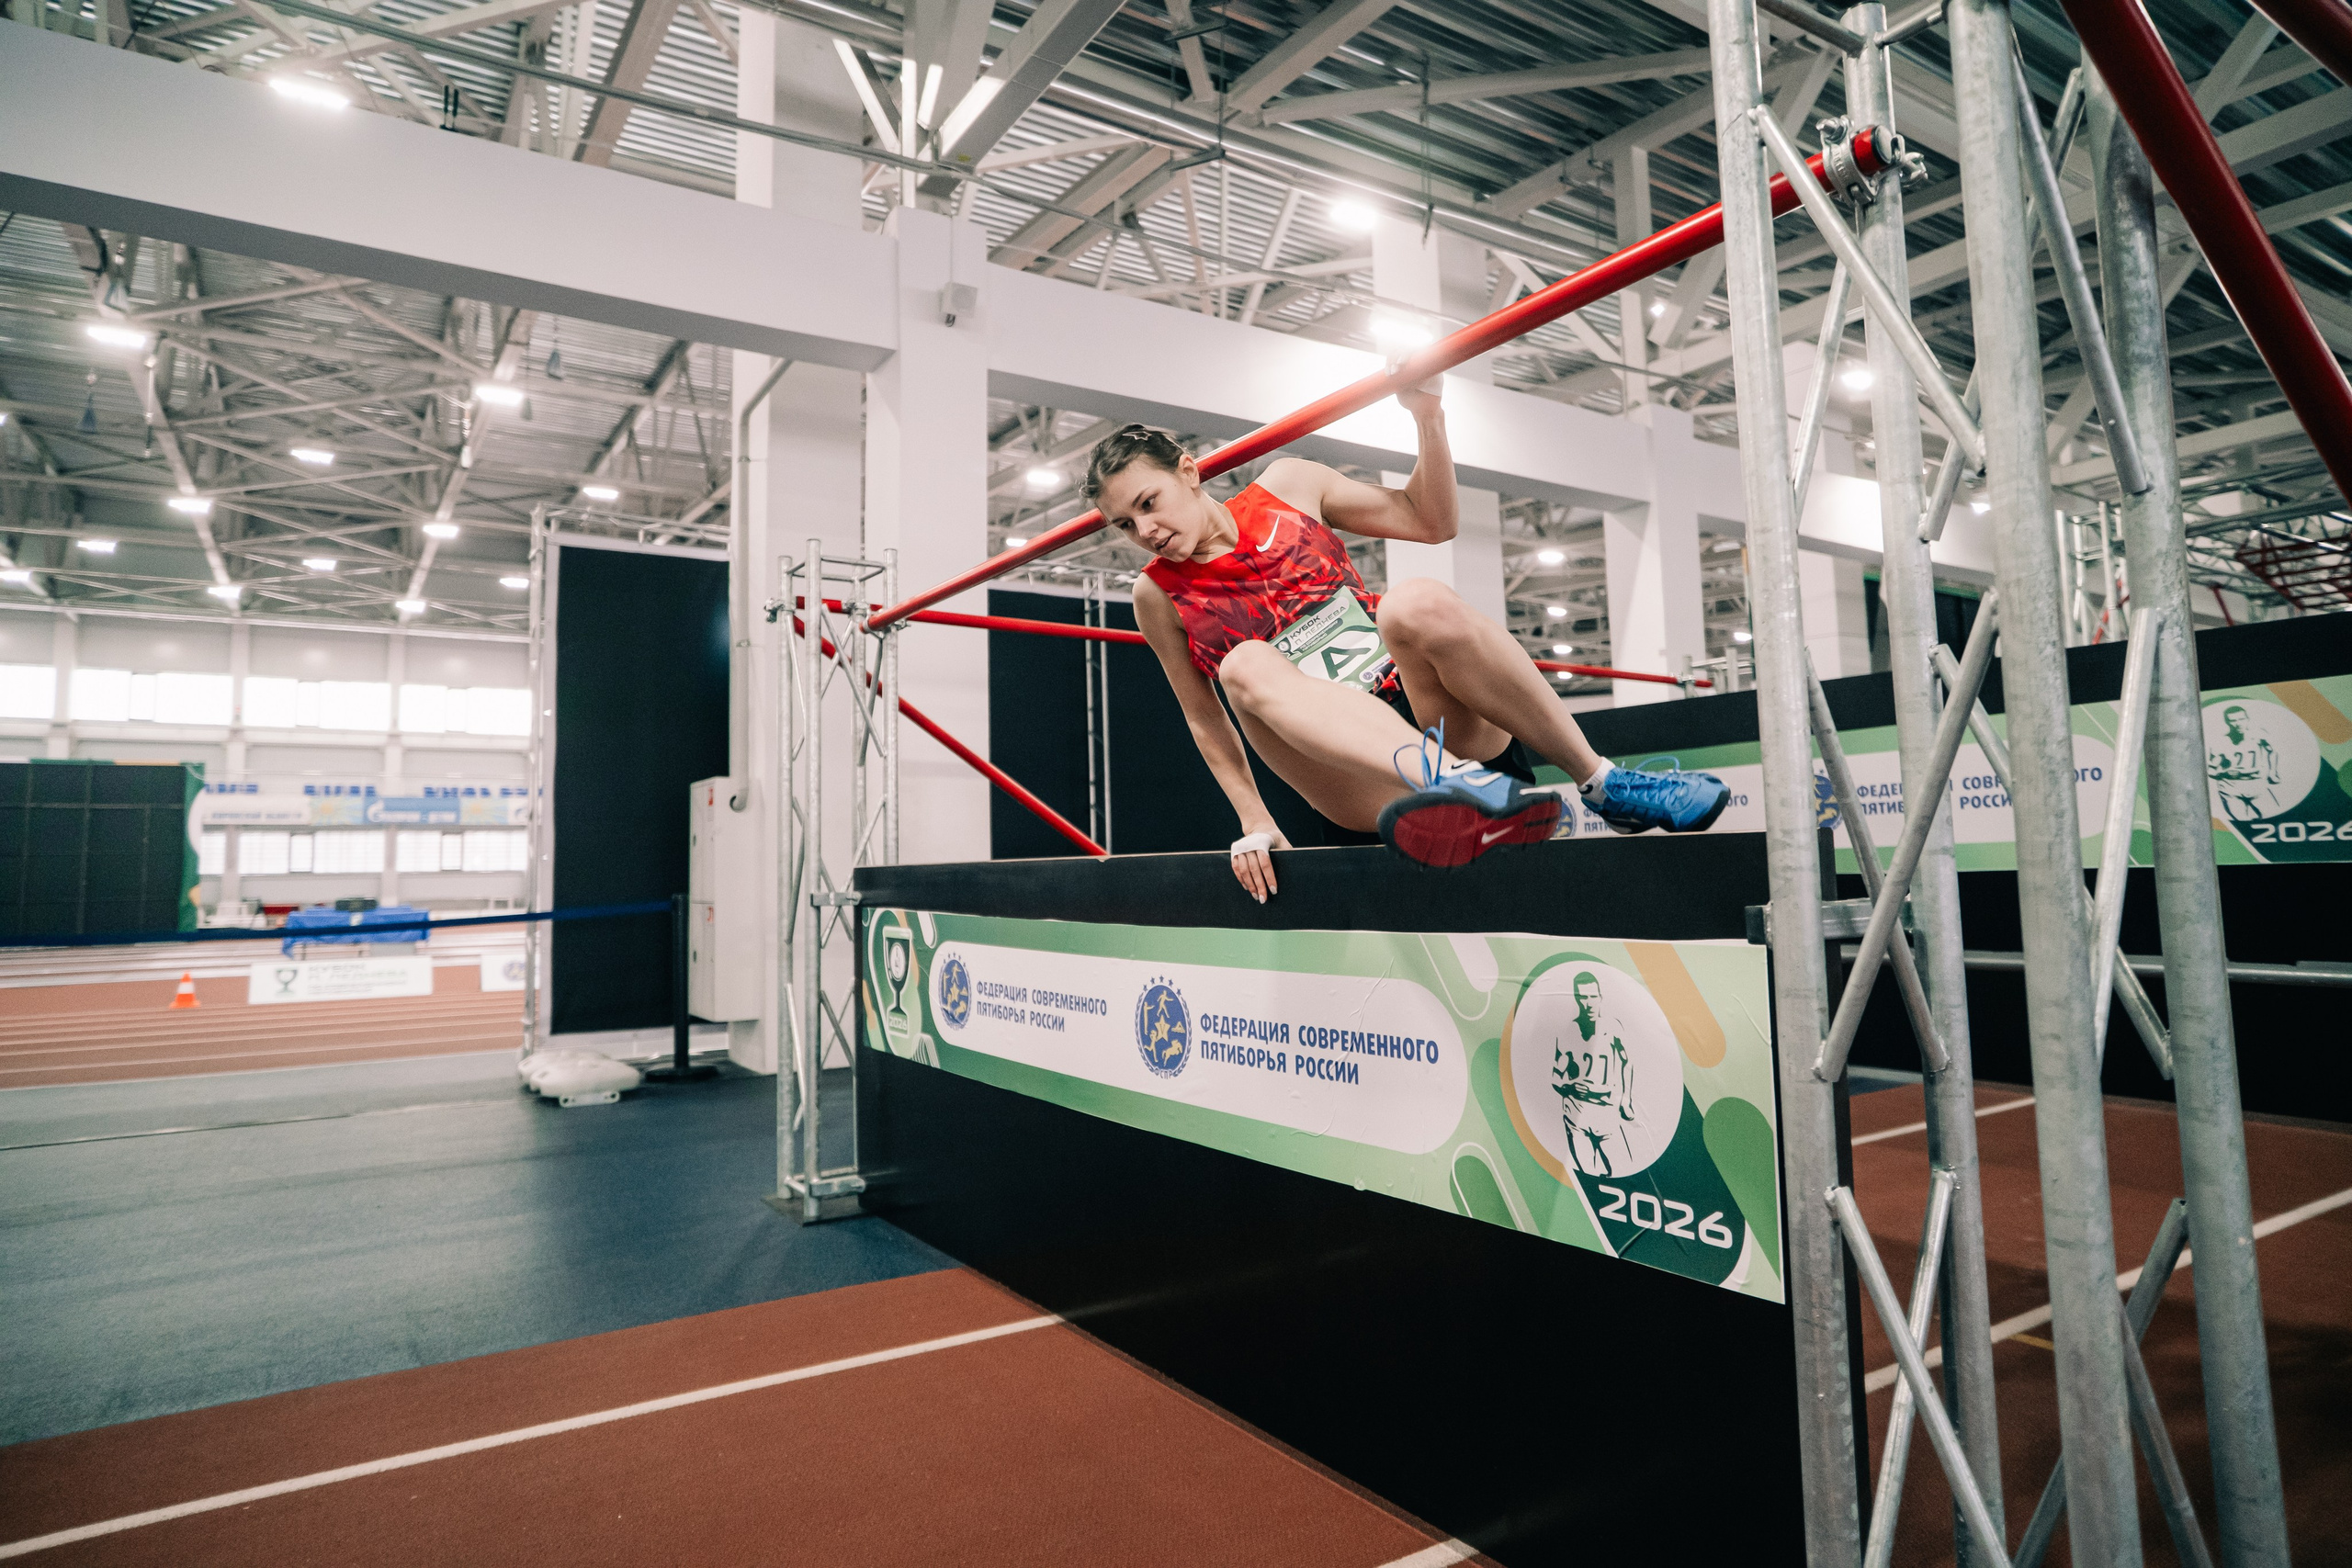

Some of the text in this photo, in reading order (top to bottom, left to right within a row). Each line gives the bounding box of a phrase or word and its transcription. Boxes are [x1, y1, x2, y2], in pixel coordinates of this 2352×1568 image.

[1290, 615, 1321, 640] КУБОК
[1305, 605, 1346, 638] ЛЕДНЕВА
[977, 981, 1107, 1017] ФЕДЕРАЦИЯ СОВРЕМЕННОГО
[977, 1000, 1065, 1032] ПЯТИБОРЬЯ РОССИИ
[888, 1016, 907, 1031] 2026
[1200, 1012, 1439, 1065] ФЕДЕРАЦИЯ СОВРЕМЕННОГО
[1201, 1039, 1360, 1086] ПЯТИБОРЬЯ РОССИИ
[1598, 1184, 1732, 1249] 2026
